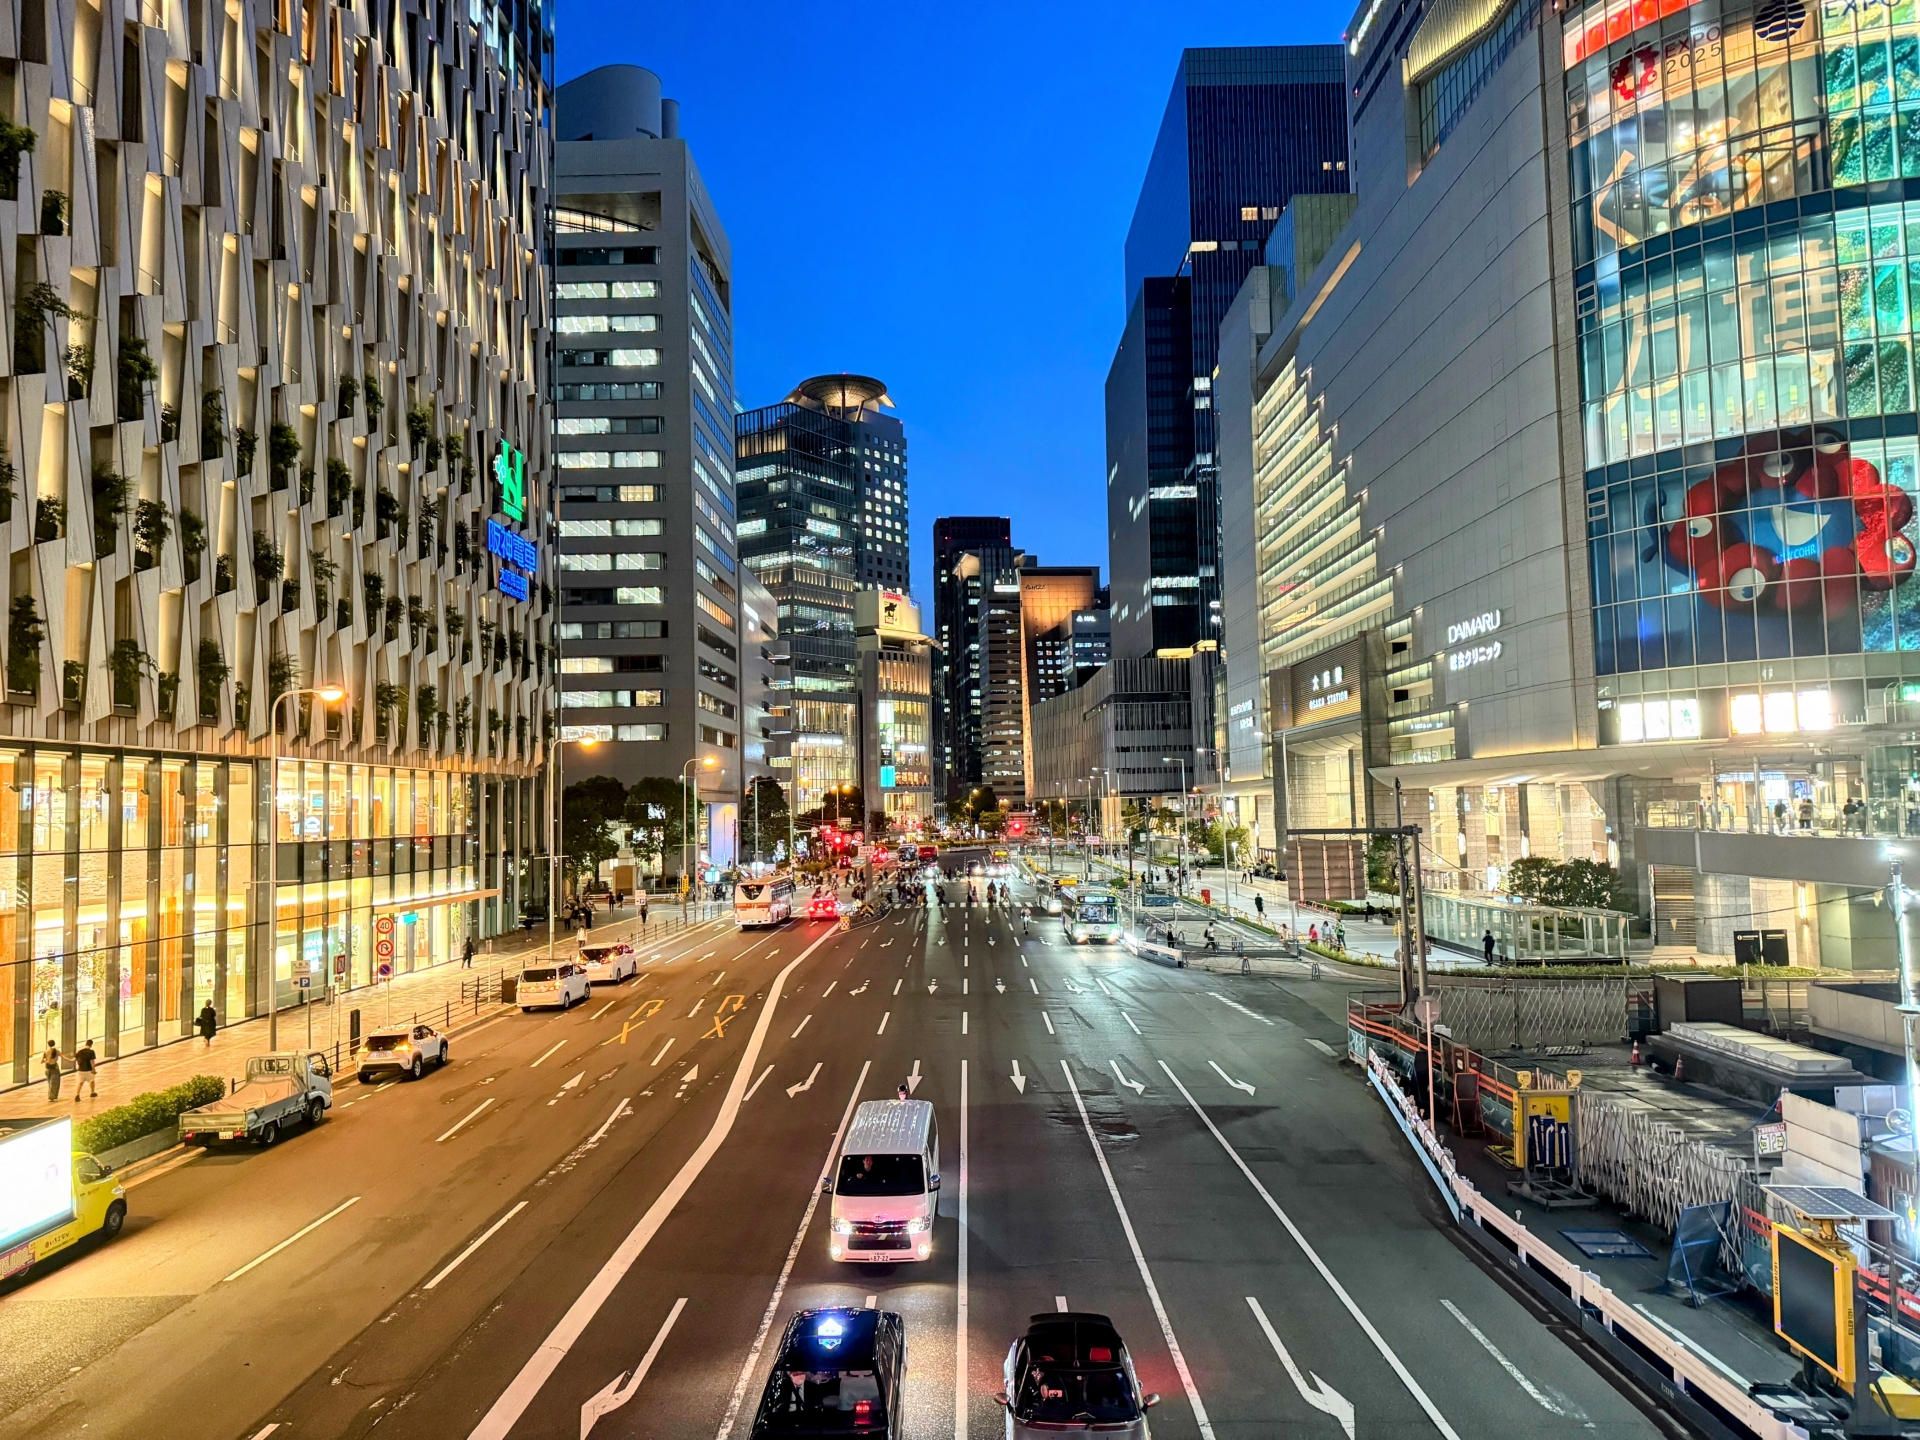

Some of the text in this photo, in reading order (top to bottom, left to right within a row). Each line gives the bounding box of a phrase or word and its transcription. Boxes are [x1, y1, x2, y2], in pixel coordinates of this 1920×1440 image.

[1665, 26, 1721, 58] EXPO
[1667, 42, 1721, 74] 2025
[488, 519, 537, 572] 阪神電車
[1448, 609, 1500, 644] DAIMARU
[1327, 690, 1348, 705] STATION
[380, 922, 390, 930] 40
